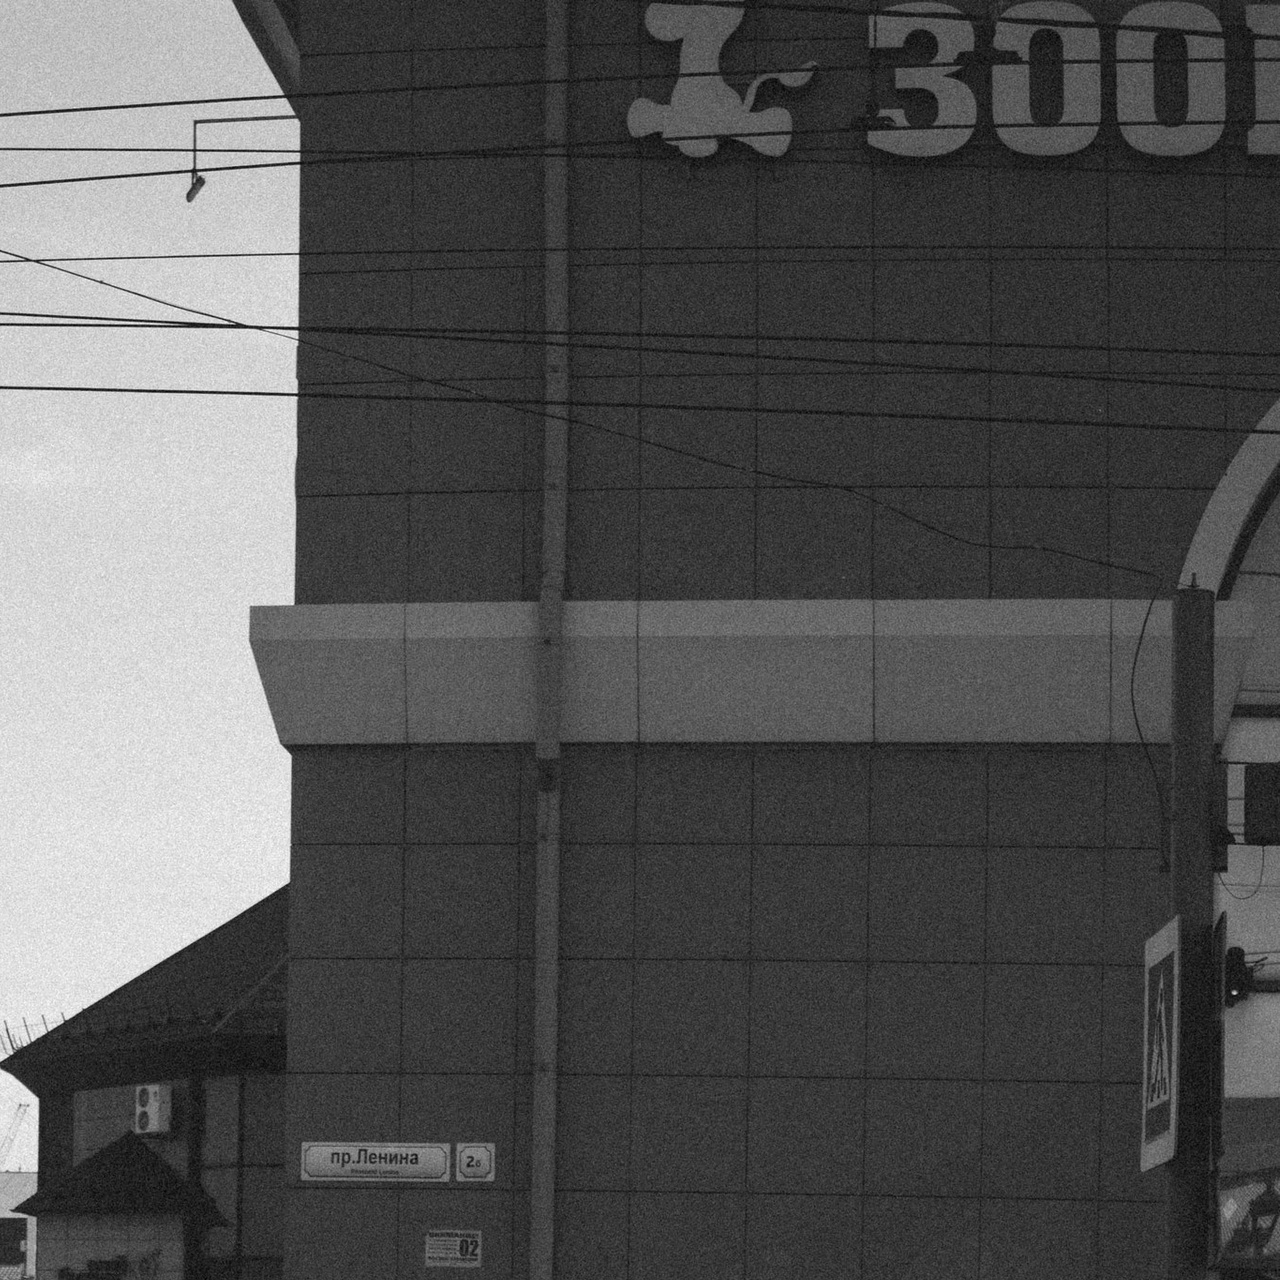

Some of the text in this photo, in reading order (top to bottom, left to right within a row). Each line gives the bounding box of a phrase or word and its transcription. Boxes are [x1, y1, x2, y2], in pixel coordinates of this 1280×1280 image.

[867, 1, 1280, 157] ЗОО
[330, 1148, 419, 1167] пр.Ленина
[459, 1238, 479, 1257] 02
